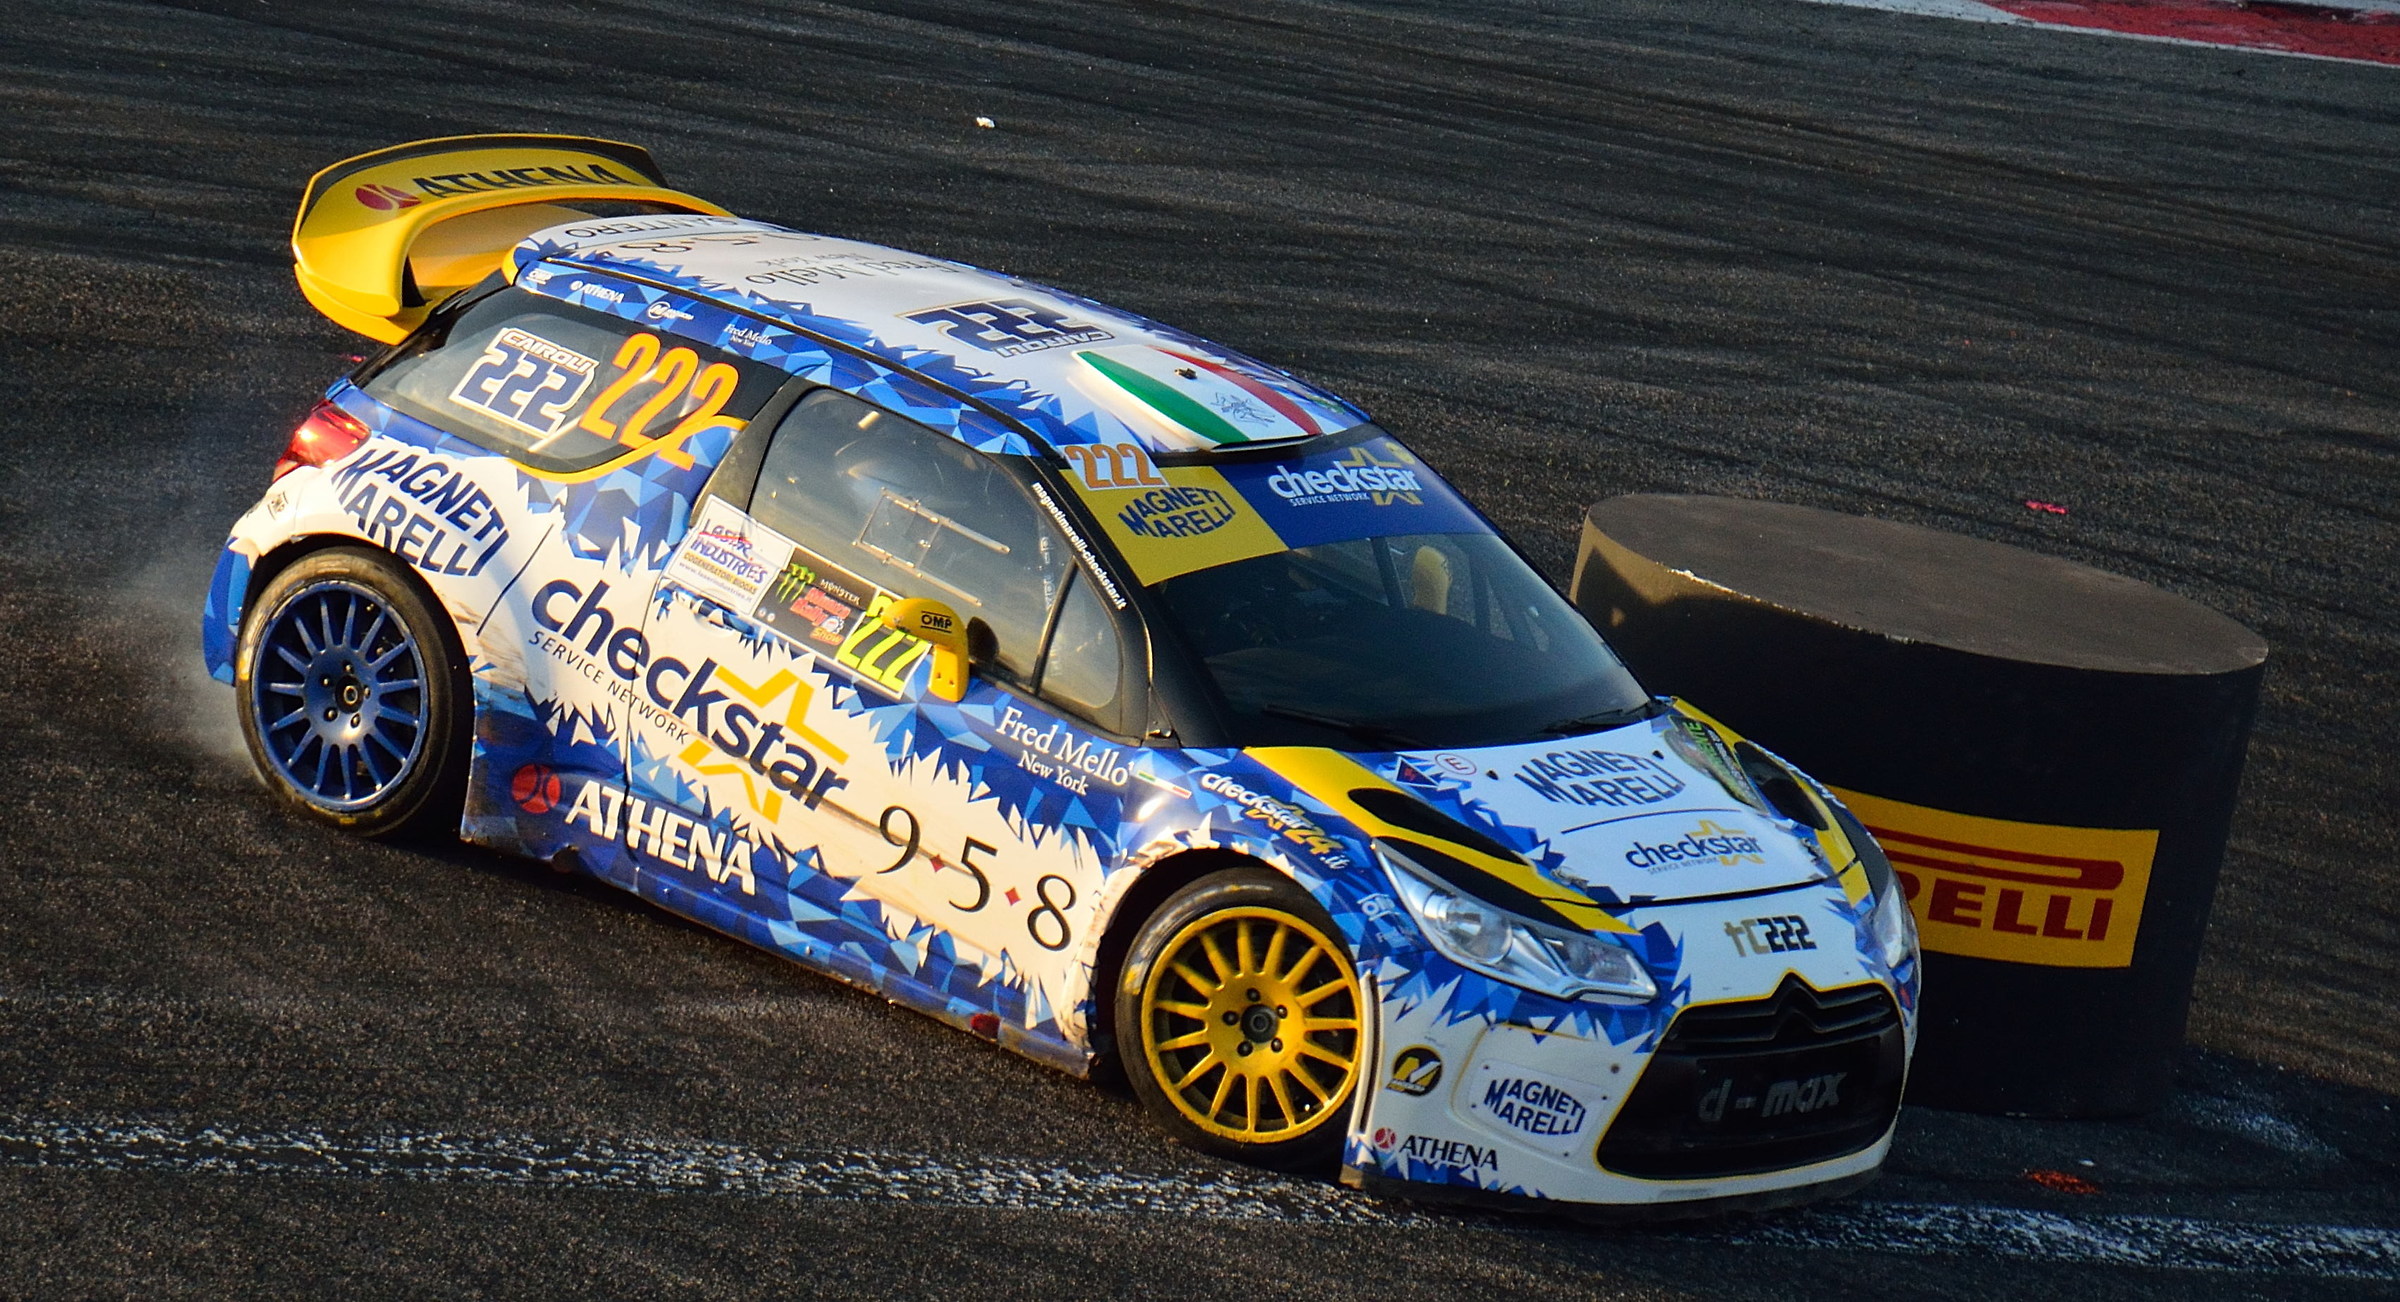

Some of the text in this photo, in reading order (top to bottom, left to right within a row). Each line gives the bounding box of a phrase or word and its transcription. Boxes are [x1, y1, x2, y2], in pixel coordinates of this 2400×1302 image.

[413, 164, 640, 199] ATHENA
[581, 283, 625, 304] ATHENA
[724, 324, 773, 346] Fred Mello
[905, 299, 1104, 352] 222
[996, 331, 1116, 358] CAIROLI
[503, 332, 593, 373] CAIROLI
[457, 343, 592, 433] 222
[580, 333, 740, 471] 222
[1064, 443, 1164, 488] 222
[1268, 461, 1422, 498] checkstar
[332, 447, 508, 545] MAGNETI
[1118, 486, 1233, 524] MAGNETI
[1290, 492, 1371, 507] SERVICE NETWORK
[332, 478, 508, 578] MARELLI
[1122, 504, 1236, 538] MARELLI
[691, 538, 767, 584] INDUSTRIES
[820, 579, 861, 606] MONSTER
[920, 614, 953, 630] OMP
[528, 630, 688, 745] SERVICE NETWORK
[531, 578, 850, 811] checkstar
[995, 706, 1128, 787] Fred Mello
[1444, 757, 1469, 772] E
[1017, 751, 1088, 797] New York
[1514, 750, 1682, 800] MAGNETI
[1514, 764, 1686, 806] MARELLI
[564, 779, 756, 896] ATHENA
[1625, 834, 1764, 869] checkstar
[1484, 1079, 1586, 1117] MAGNETI
[1484, 1099, 1586, 1136] MARELLI
[1399, 1135, 1498, 1171] ATHENA
